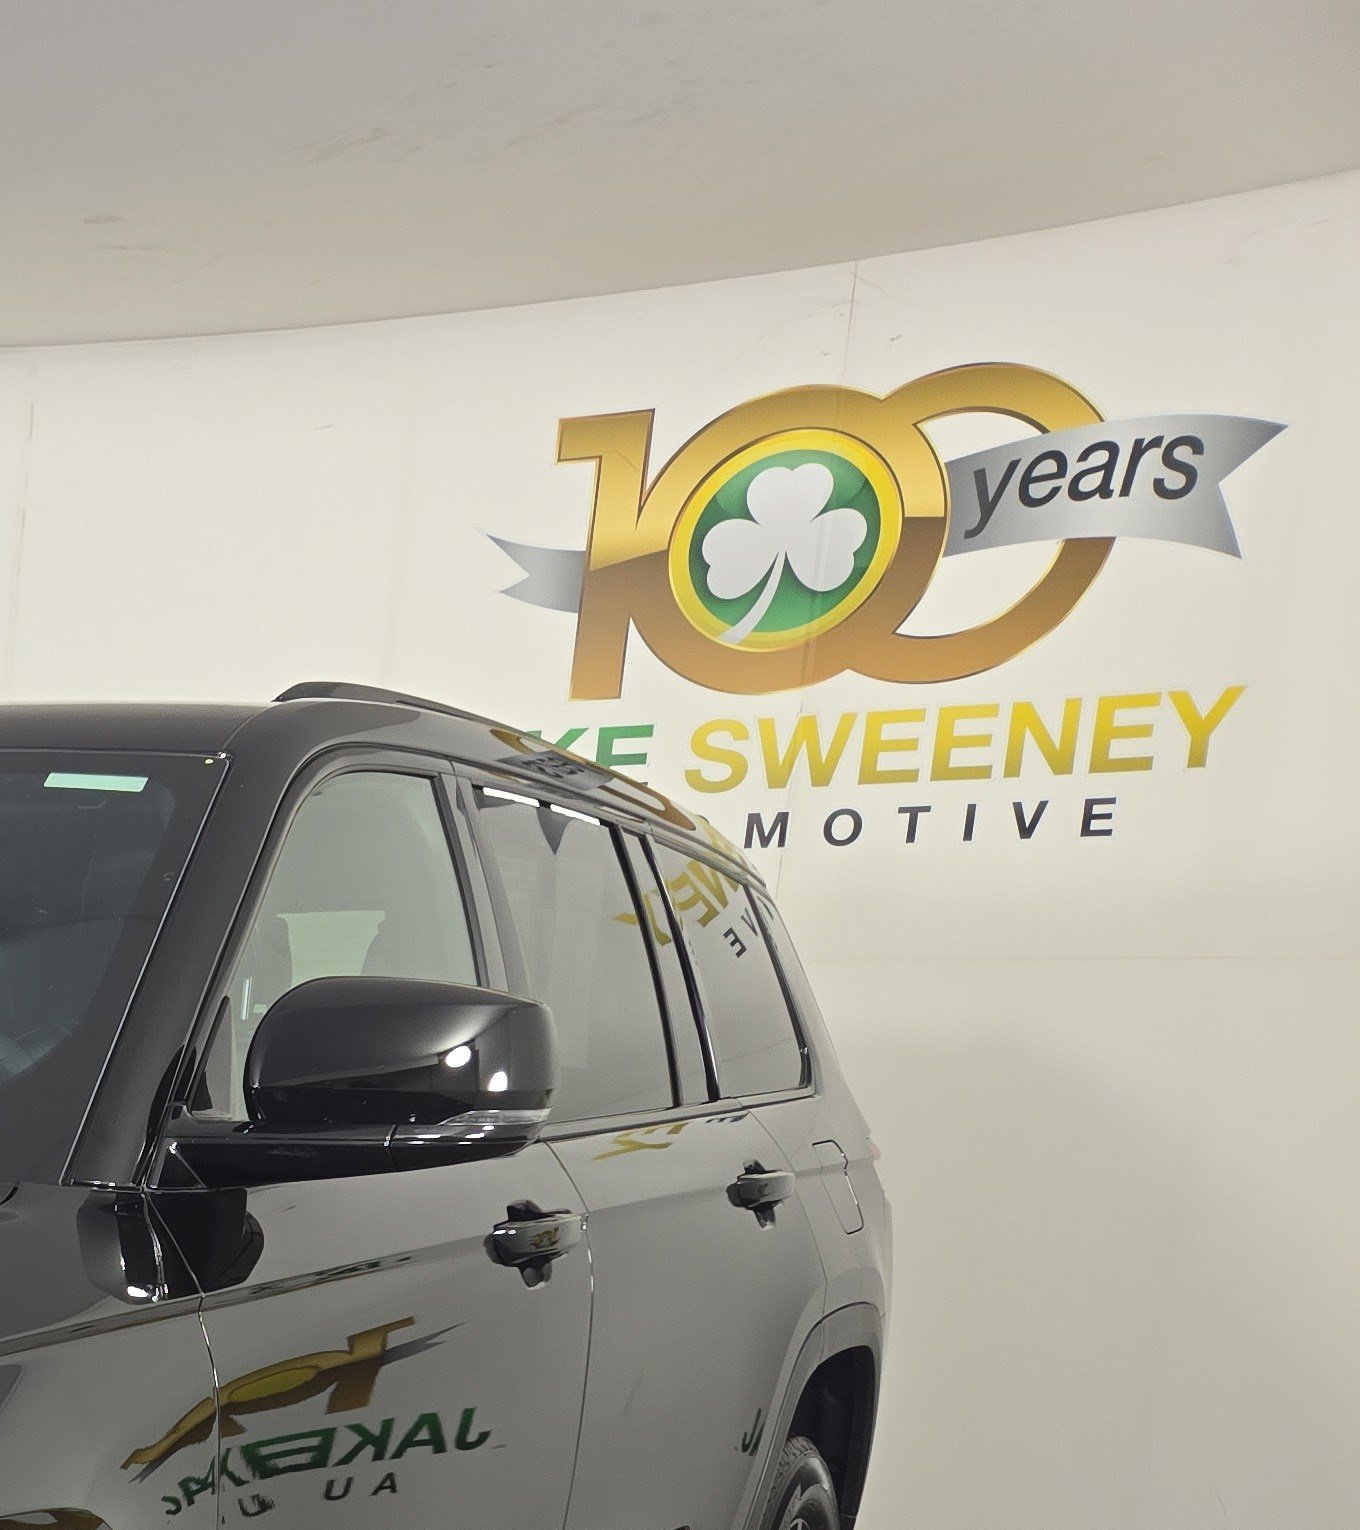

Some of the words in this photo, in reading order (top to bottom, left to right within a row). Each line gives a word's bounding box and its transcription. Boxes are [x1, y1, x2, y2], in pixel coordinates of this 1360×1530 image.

[555, 361, 1116, 701] 100
[963, 434, 1205, 541] years
[683, 685, 1247, 795] SWEENEY
